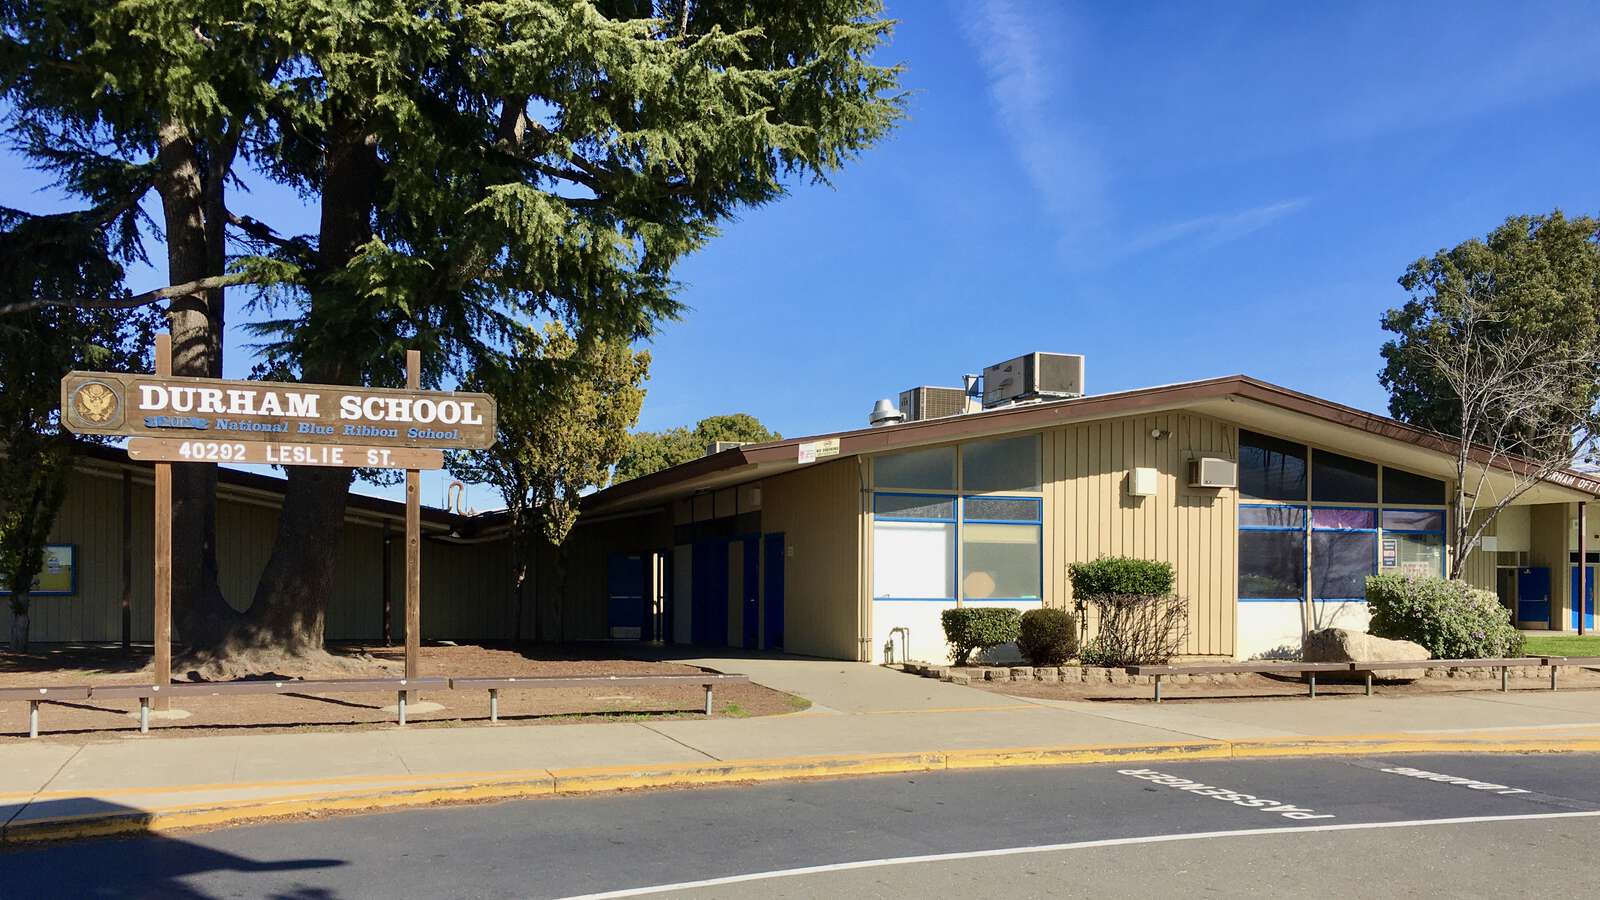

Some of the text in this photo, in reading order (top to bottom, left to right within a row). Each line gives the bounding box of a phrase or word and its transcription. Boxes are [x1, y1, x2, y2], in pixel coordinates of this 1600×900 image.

[138, 385, 483, 425] DURHAM SCHOOL
[215, 417, 289, 433] National
[297, 422, 334, 436] Blue
[342, 424, 399, 438] Ribbon
[178, 441, 396, 466] 40292 LESLIE ST.
[1578, 479, 1600, 493] OFFI
[1117, 767, 1336, 821] PASSENGER
